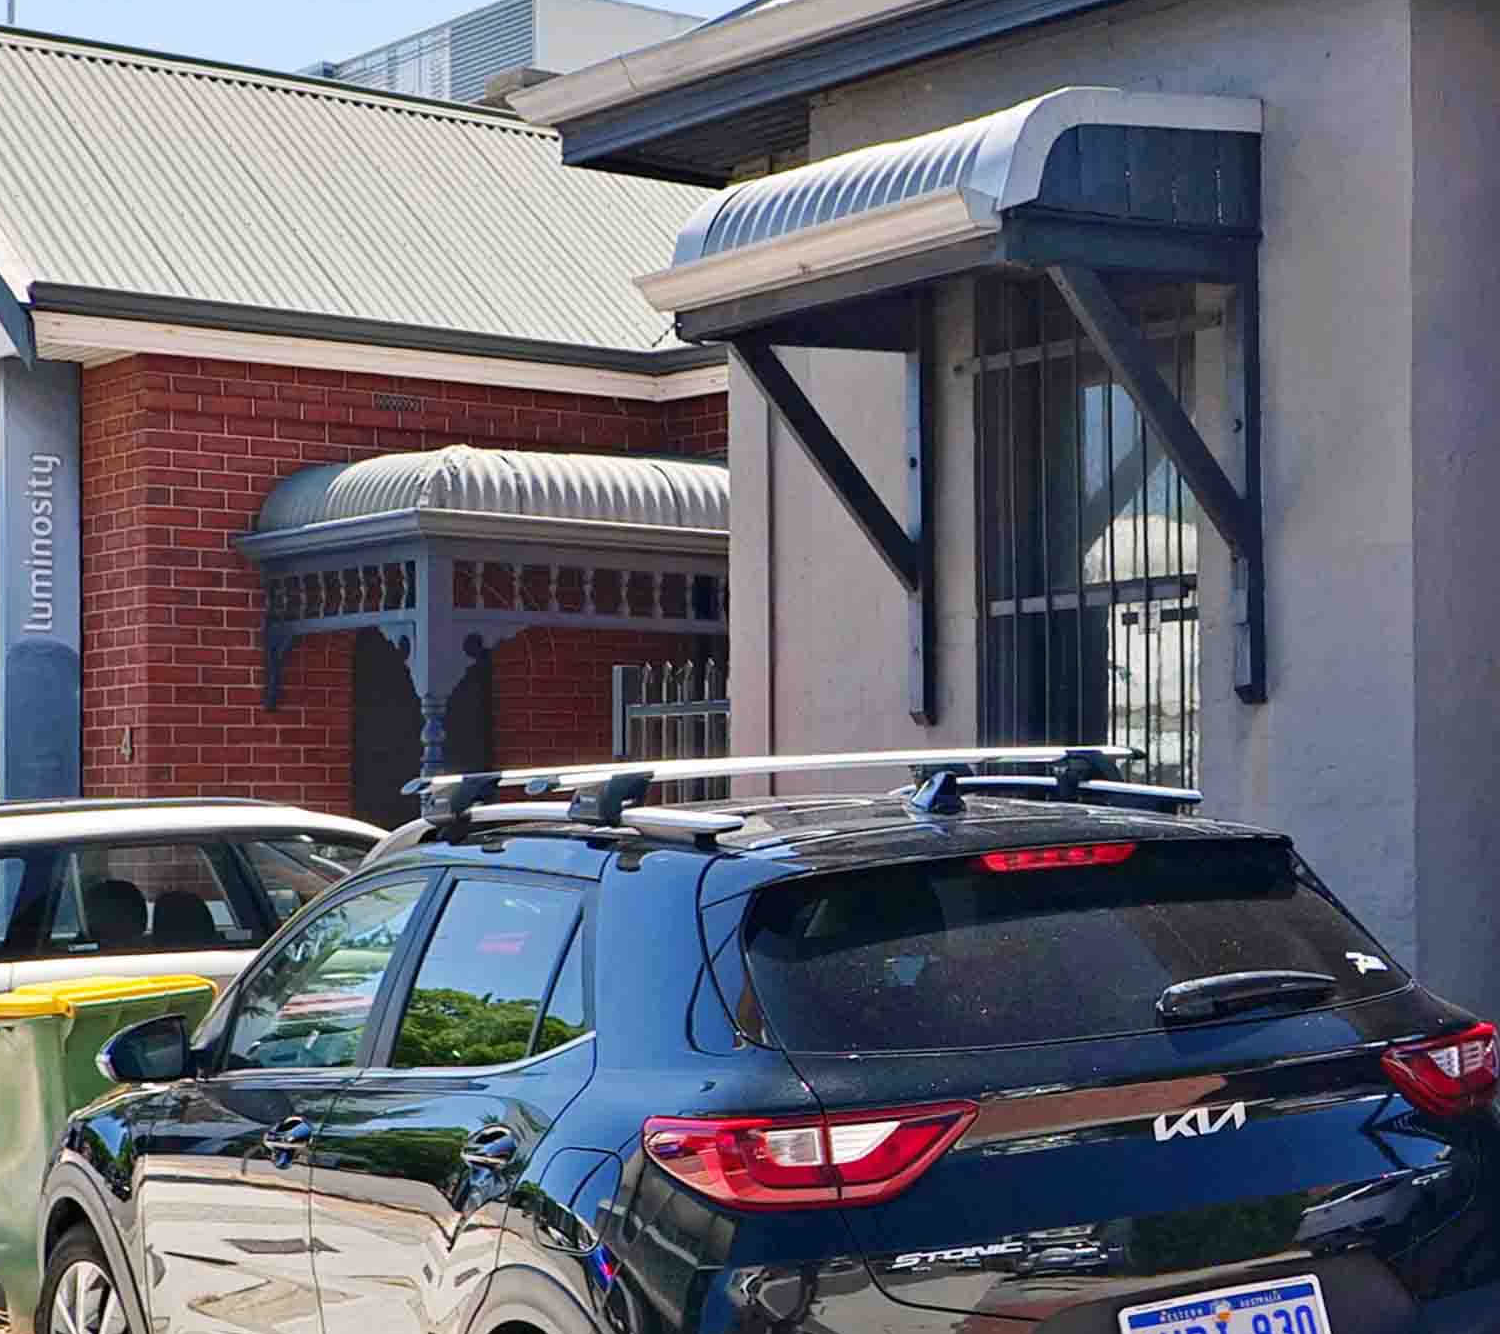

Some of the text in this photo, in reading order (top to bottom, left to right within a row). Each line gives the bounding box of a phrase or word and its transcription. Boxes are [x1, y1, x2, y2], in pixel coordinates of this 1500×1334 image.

[23, 453, 60, 633] luminosity
[118, 725, 133, 762] 4
[1154, 1101, 1246, 1141] KIA
[891, 1241, 1024, 1269] STONIC
